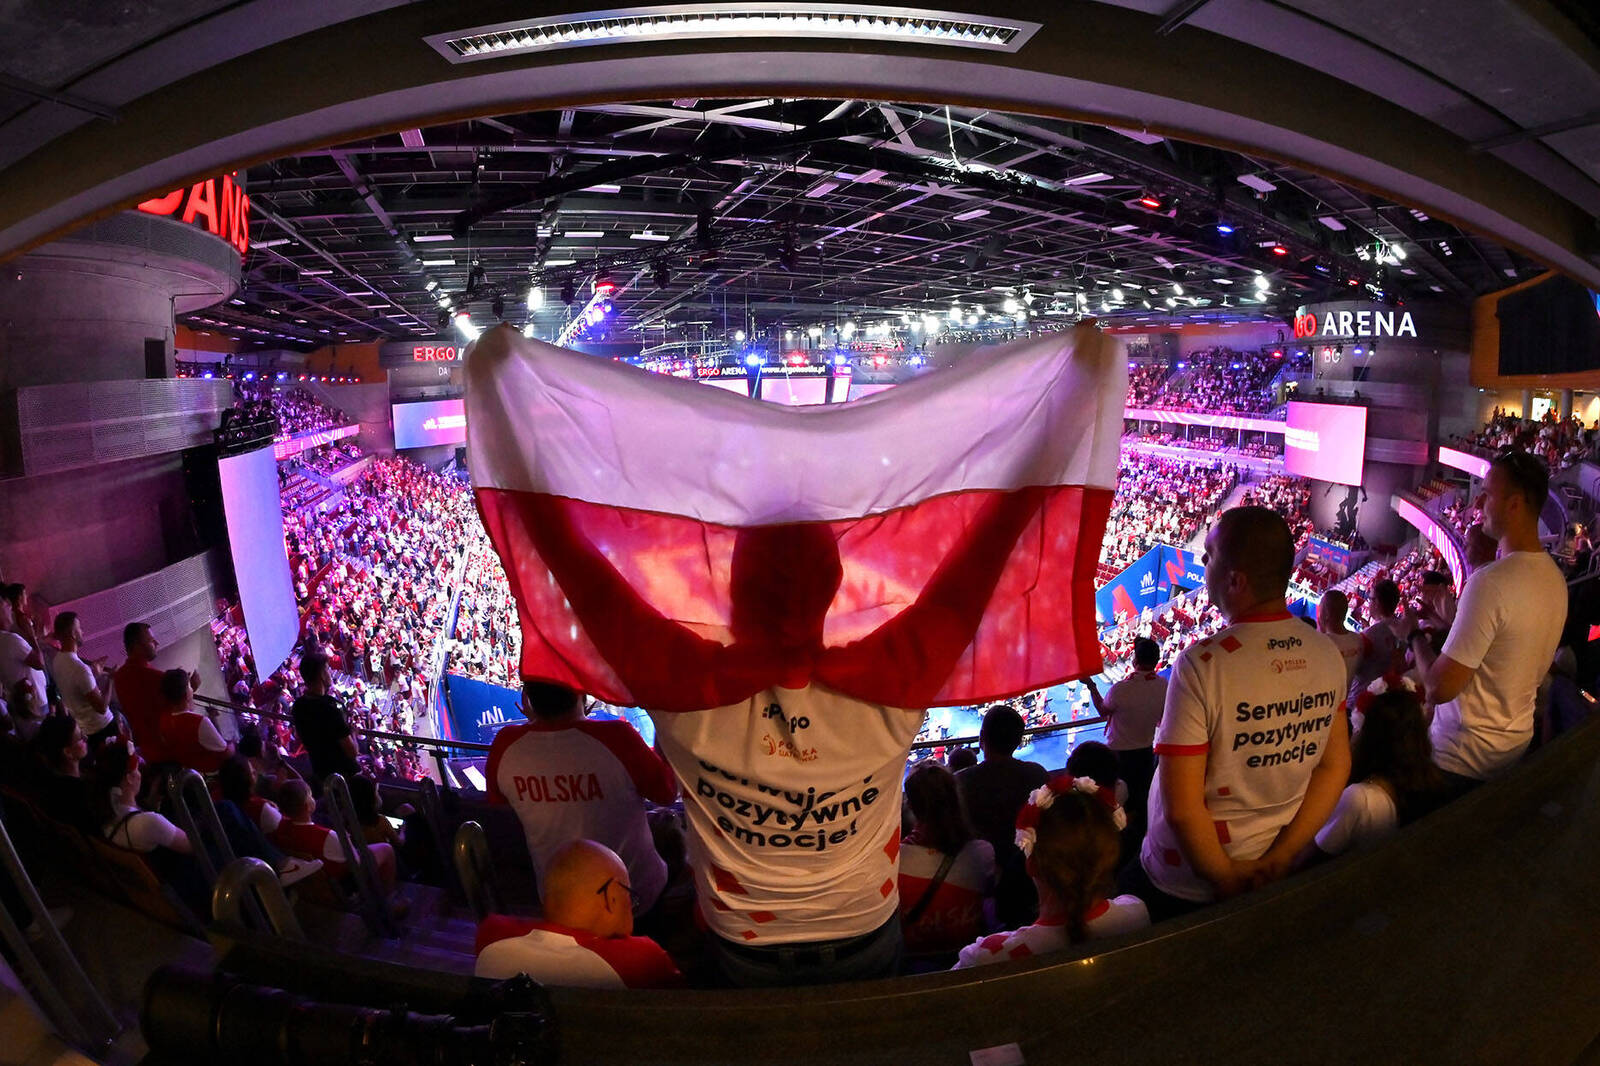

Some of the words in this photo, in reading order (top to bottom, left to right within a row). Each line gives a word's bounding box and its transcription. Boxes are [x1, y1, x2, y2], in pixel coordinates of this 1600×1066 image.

[1322, 311, 1417, 337] ARENA
[413, 346, 456, 361] ERGO
[698, 368, 720, 376] ERGO
[721, 367, 747, 375] ARENA
[1187, 571, 1206, 584] POLA
[1236, 690, 1336, 722] Serwujemy
[513, 773, 604, 803] POLSKA
